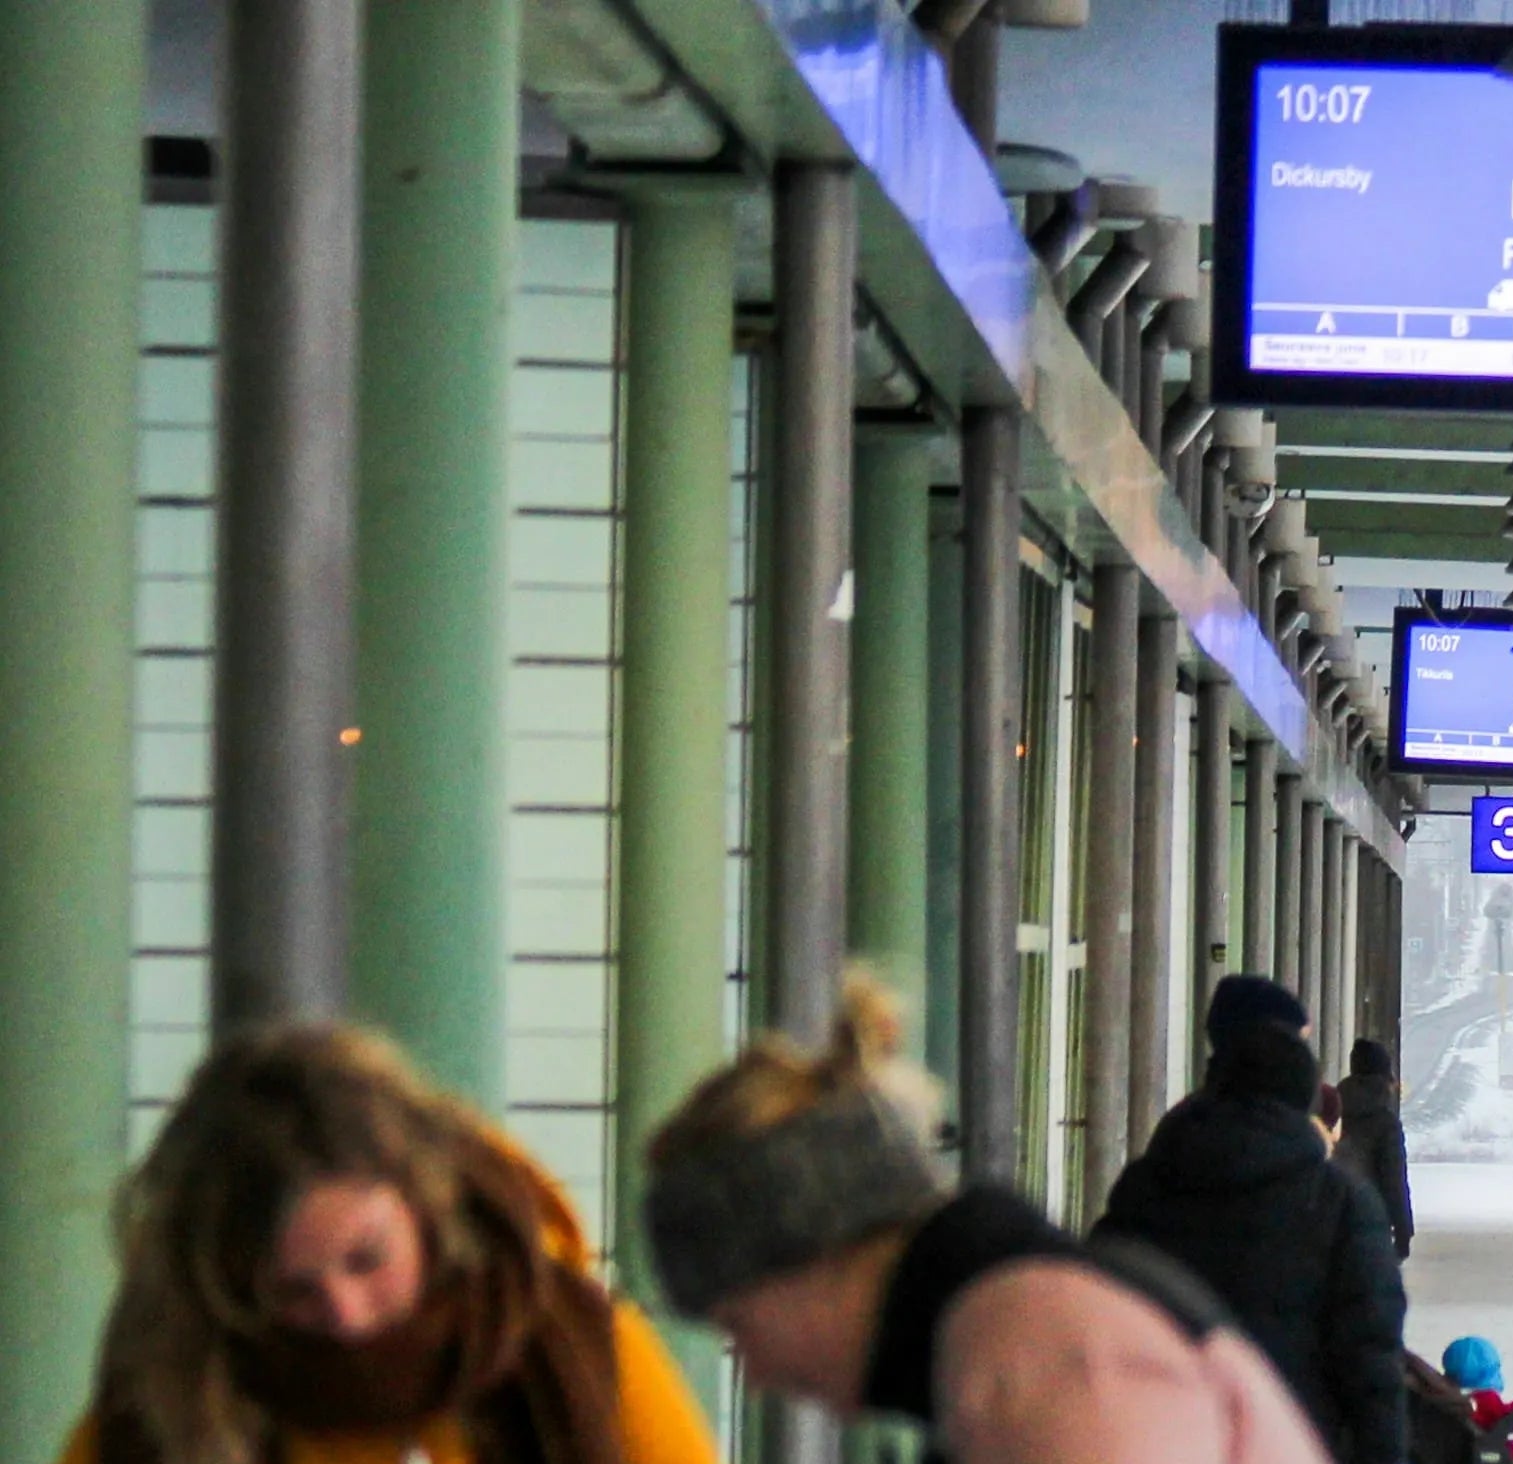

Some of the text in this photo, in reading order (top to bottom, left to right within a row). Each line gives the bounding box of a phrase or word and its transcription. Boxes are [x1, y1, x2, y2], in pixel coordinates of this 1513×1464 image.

[1276, 84, 1372, 123] 10:07
[1271, 161, 1373, 194] Dickursby
[1315, 311, 1336, 334] A
[1450, 315, 1469, 338] B
[1418, 634, 1461, 651] 10:07
